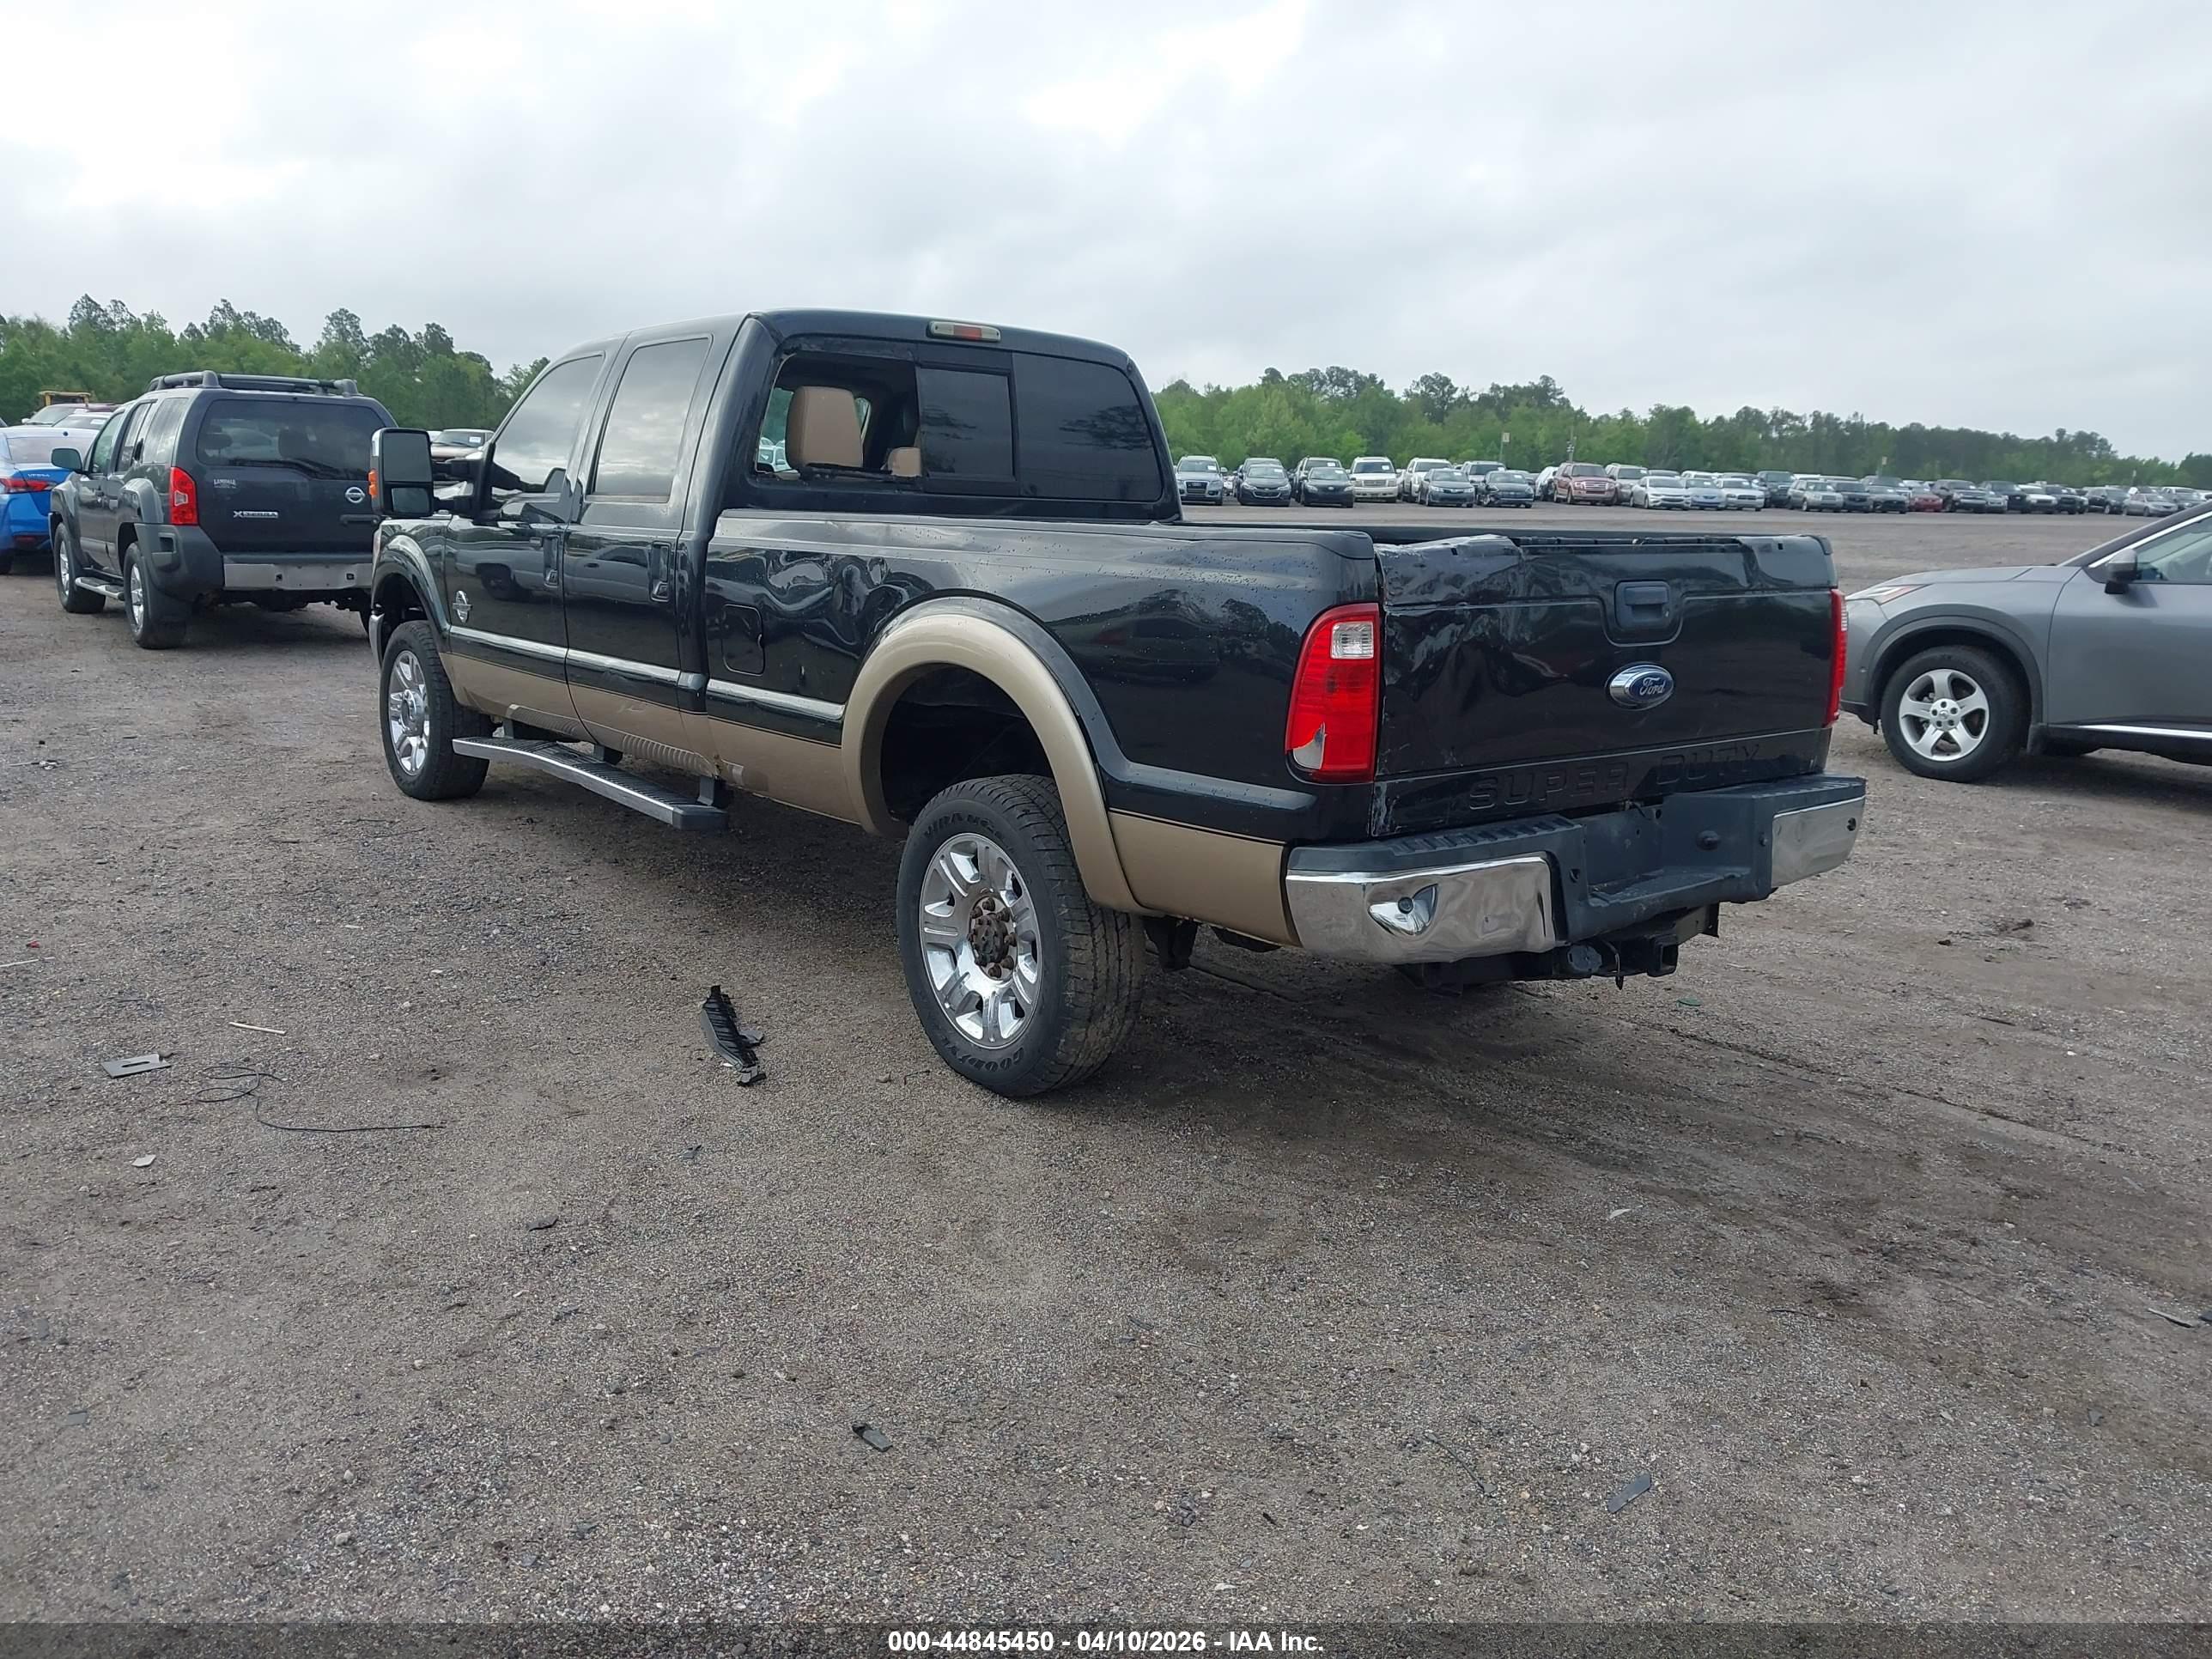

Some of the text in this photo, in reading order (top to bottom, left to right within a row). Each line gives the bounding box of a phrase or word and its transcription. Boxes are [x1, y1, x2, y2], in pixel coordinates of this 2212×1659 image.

[1639, 677, 1667, 696] Ford
[1469, 743, 1759, 810] SUPER DUTY
